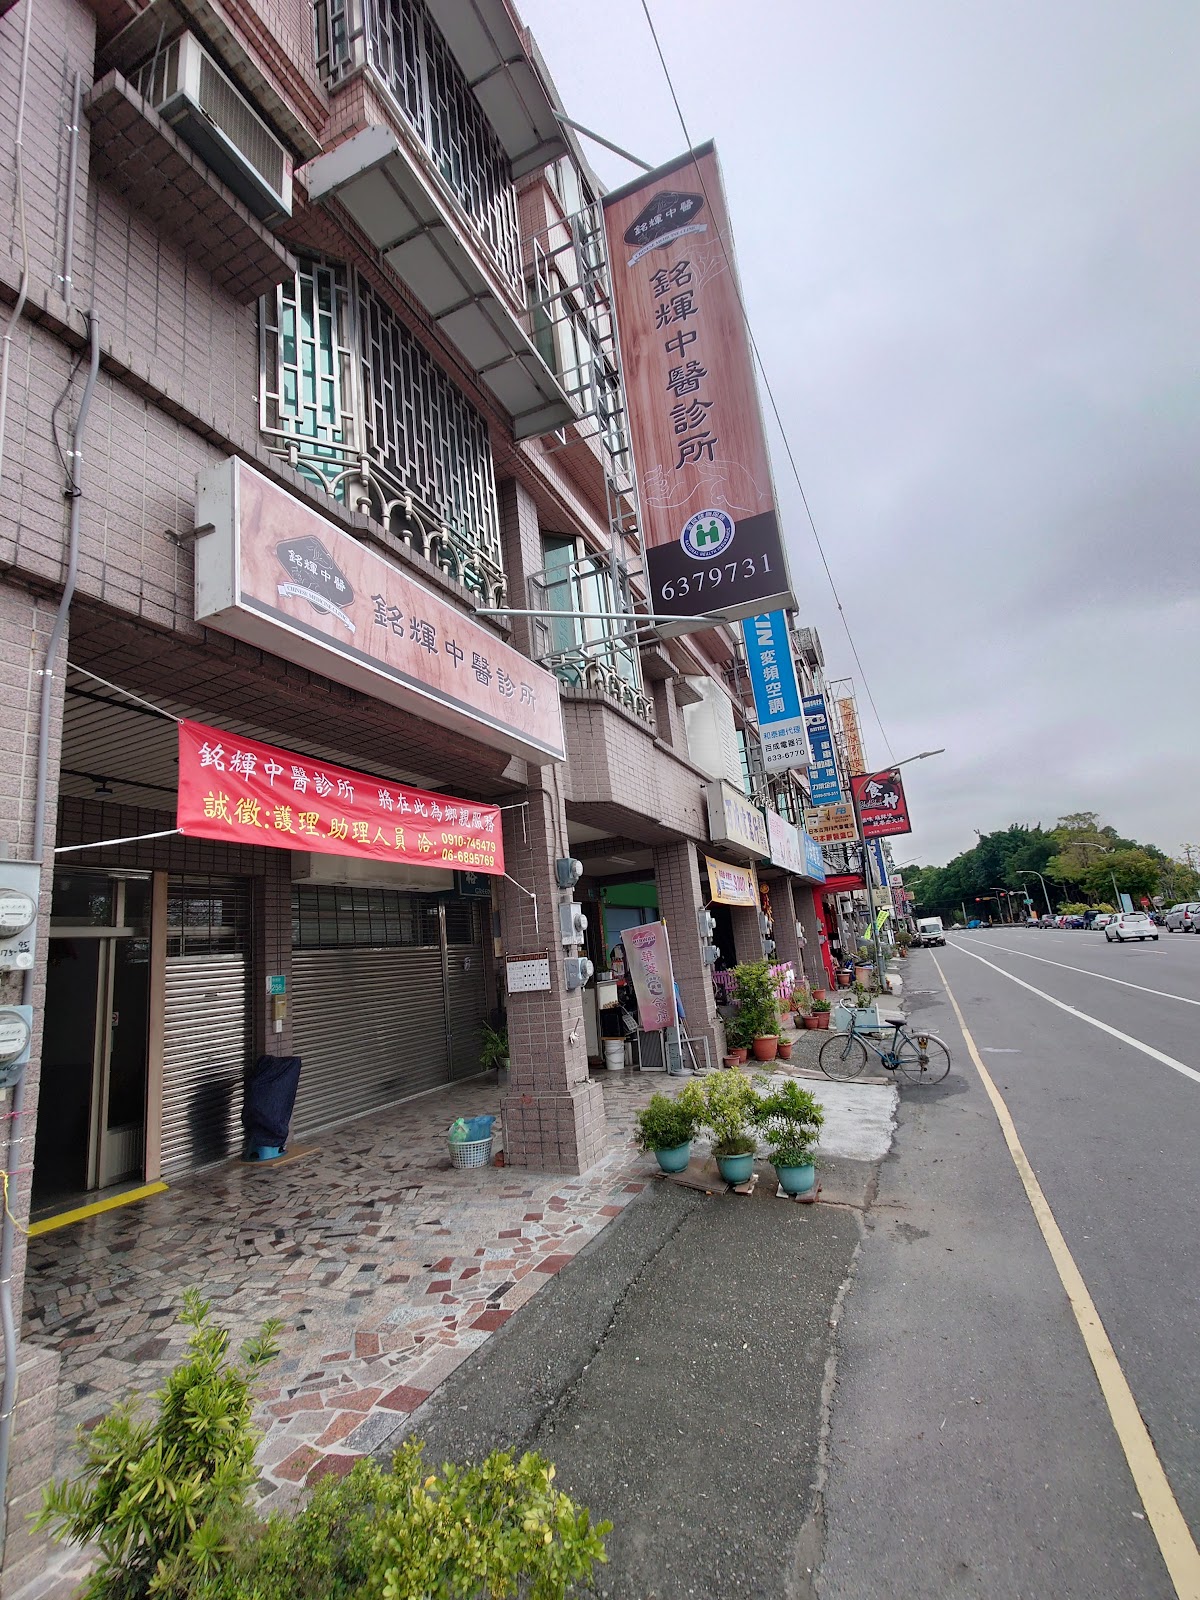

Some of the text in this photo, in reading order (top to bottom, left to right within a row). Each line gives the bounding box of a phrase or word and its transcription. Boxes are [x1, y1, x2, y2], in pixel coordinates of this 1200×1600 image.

[633, 199, 693, 236] 銘輝中醫
[650, 260, 718, 470] 銘輝中醫診所
[288, 549, 346, 592] 銘輝中醫
[661, 553, 772, 600] 6379731
[371, 593, 537, 712] 銘輝中醫診所
[765, 738, 803, 752] 百成電器行
[198, 742, 495, 833] 銘輝中醫診所 將在此為鄉親服務
[865, 781, 899, 809] 食神
[441, 832, 496, 852] 0910-745479
[441, 848, 495, 866] 06-6895769
